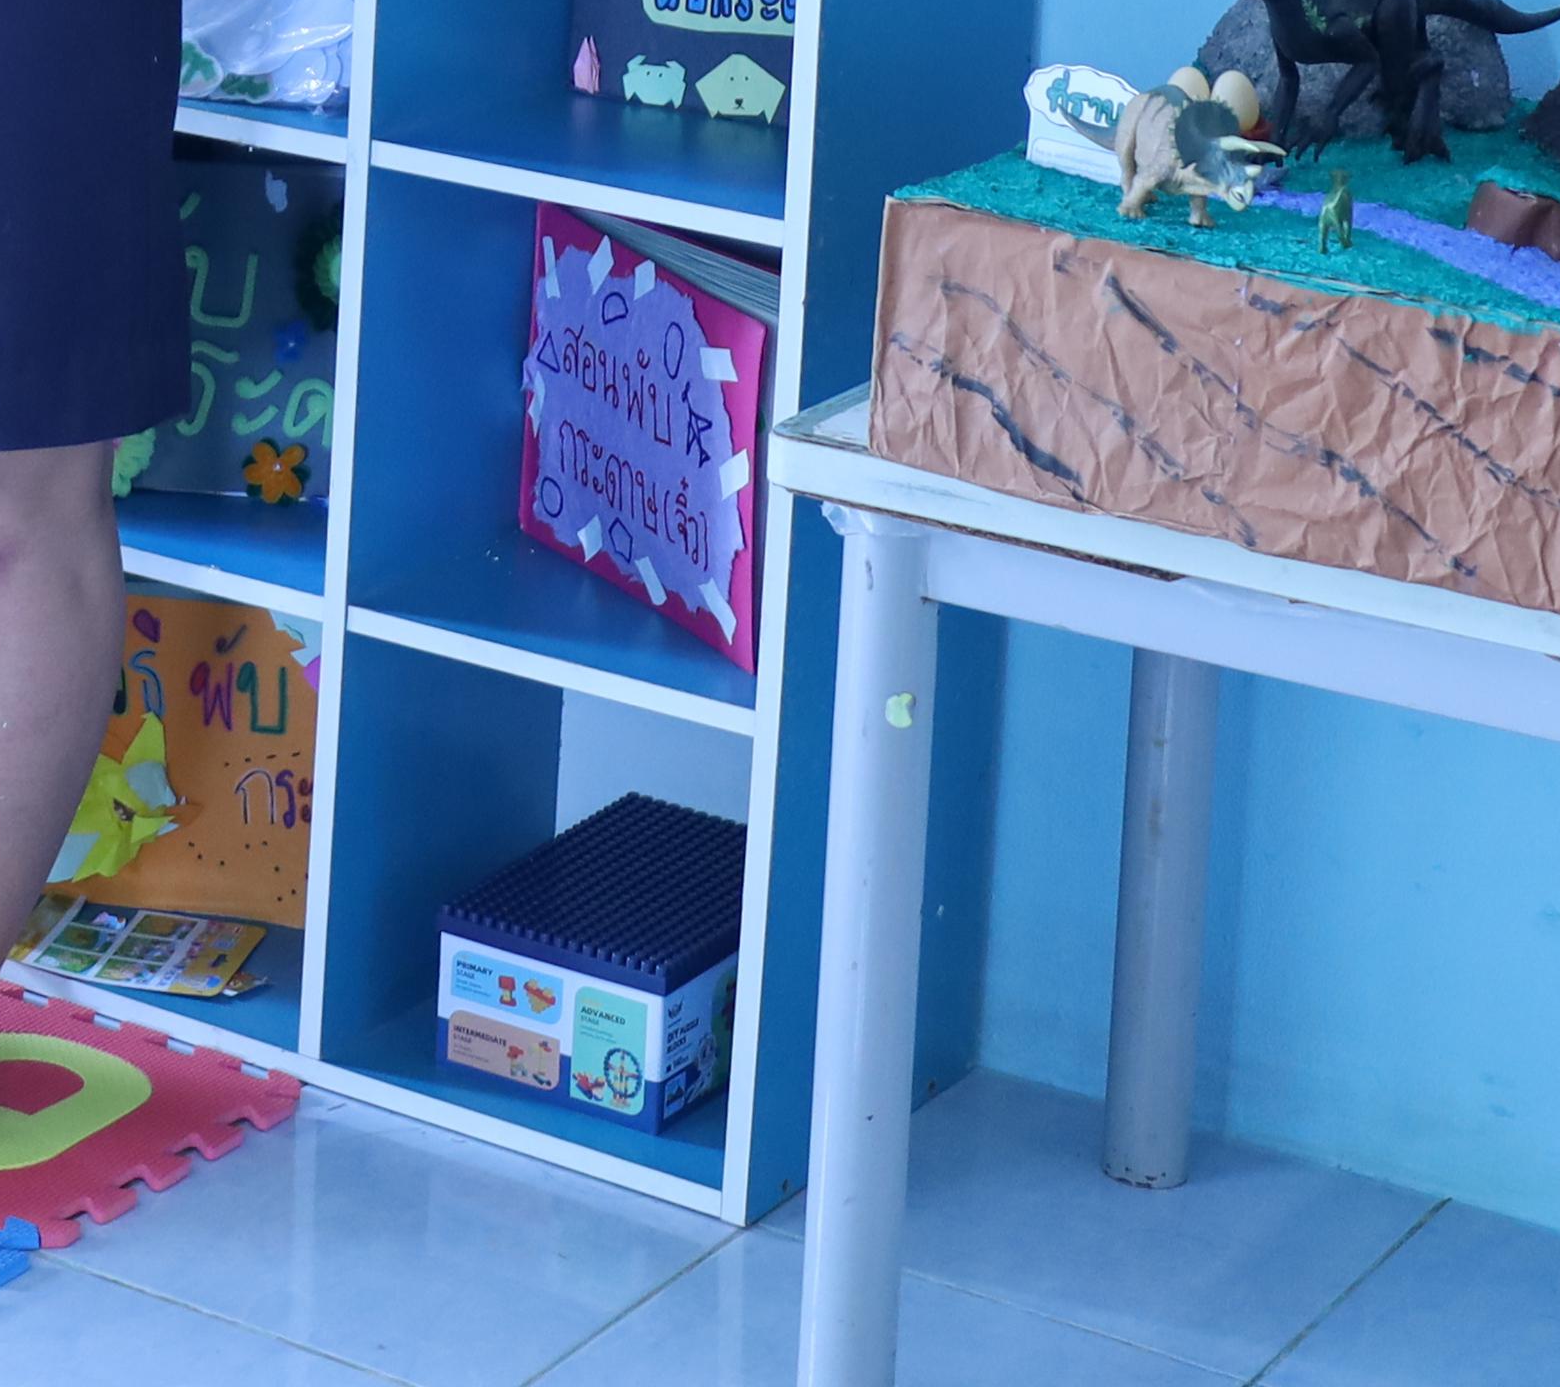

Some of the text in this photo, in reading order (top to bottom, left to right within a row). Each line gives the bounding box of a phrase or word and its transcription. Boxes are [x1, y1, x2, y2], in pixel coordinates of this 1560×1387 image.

[563, 325, 672, 446] สอนพับ
[190, 624, 287, 735] พับ
[456, 959, 493, 977] PRIMARY
[580, 1005, 626, 1026] ADVANCED
[452, 1024, 508, 1048] INTERMEDIATE
